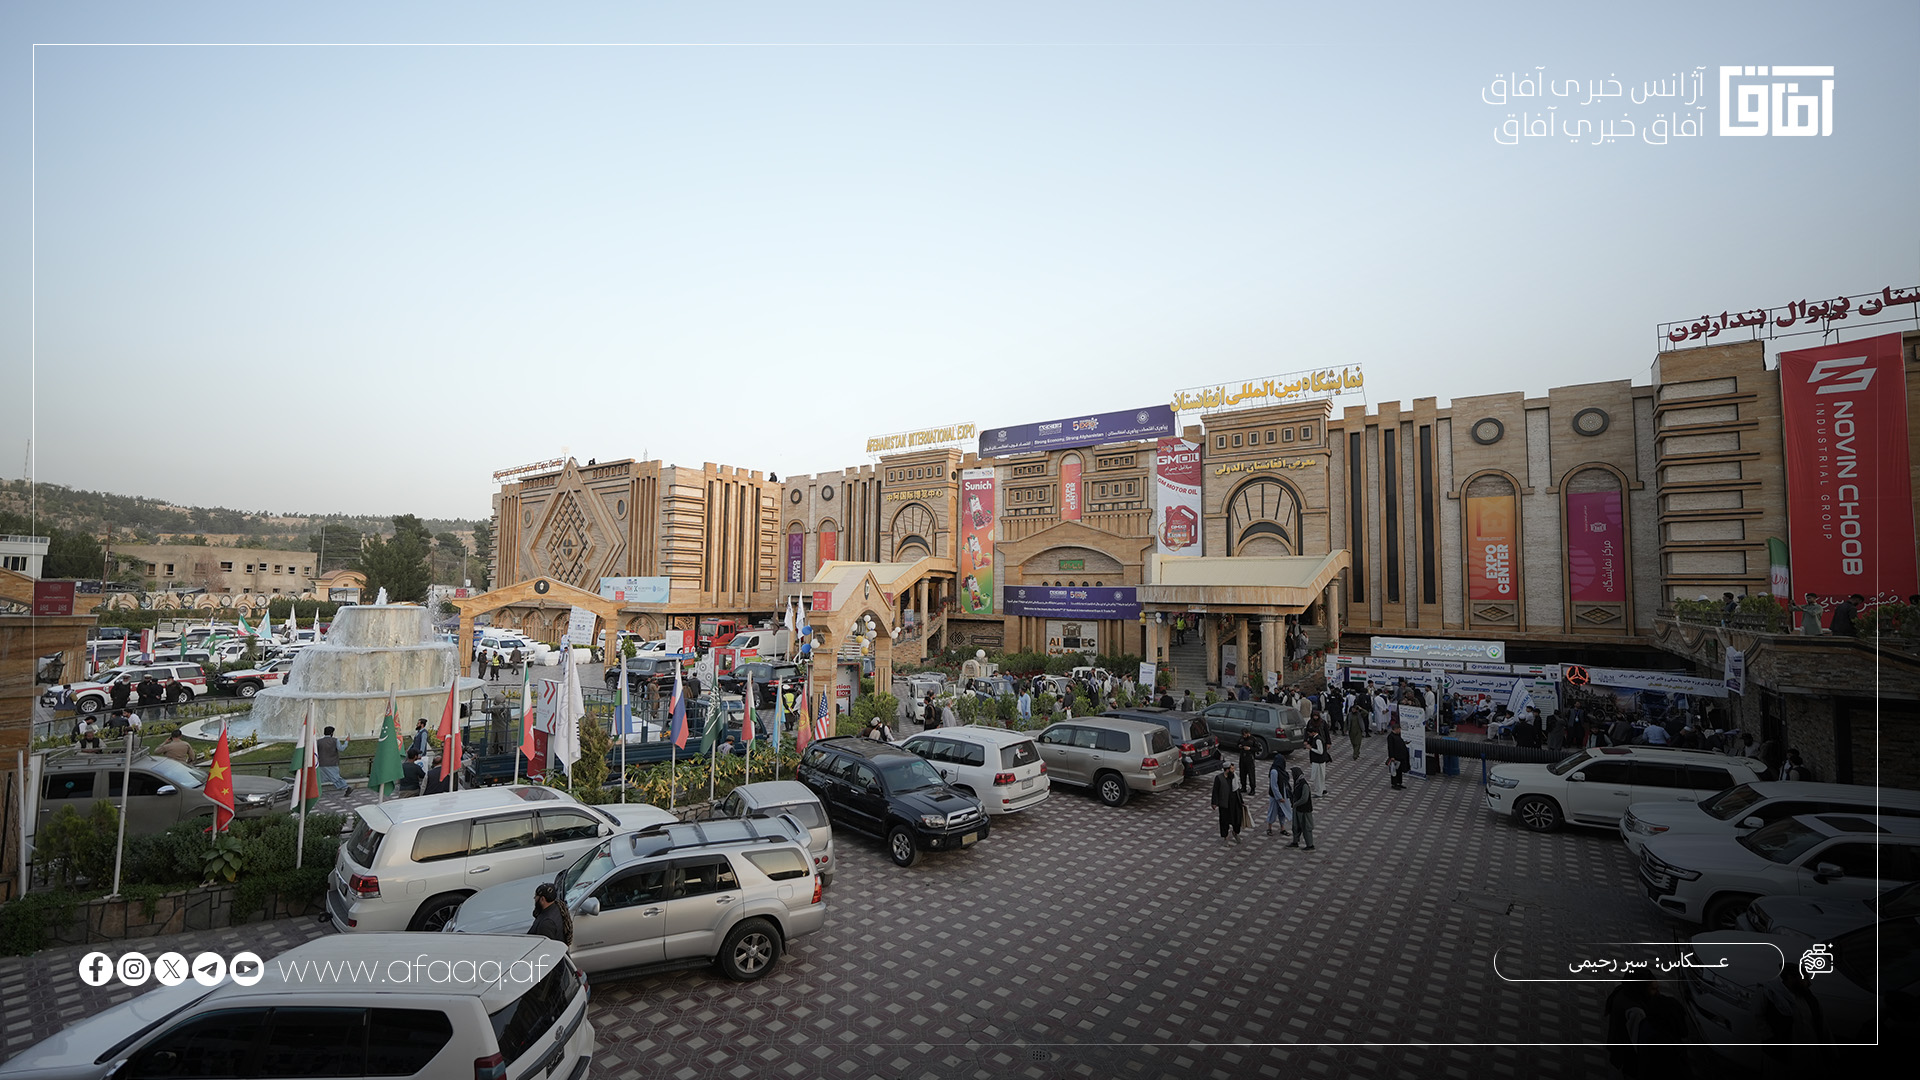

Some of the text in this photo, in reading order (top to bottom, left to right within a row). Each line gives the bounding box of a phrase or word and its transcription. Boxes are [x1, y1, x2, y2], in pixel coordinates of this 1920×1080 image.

[1169, 366, 1364, 412] نمایشگاه بین المللی افغانستان
[866, 423, 975, 452] AFGHANISTAN INTERNATIONAL EXPO
[1246, 457, 1288, 474] افغانستان
[1815, 402, 1832, 540] INDUSTRIAL GROUP
[964, 480, 992, 491] Sunich
[1166, 481, 1187, 494] MOTOR
[1833, 400, 1863, 575] NOVIN CHOOB
[1485, 544, 1498, 579] EXPO
[1497, 544, 1510, 594] CENTER
[1602, 558, 1615, 593] نمایشگاه
